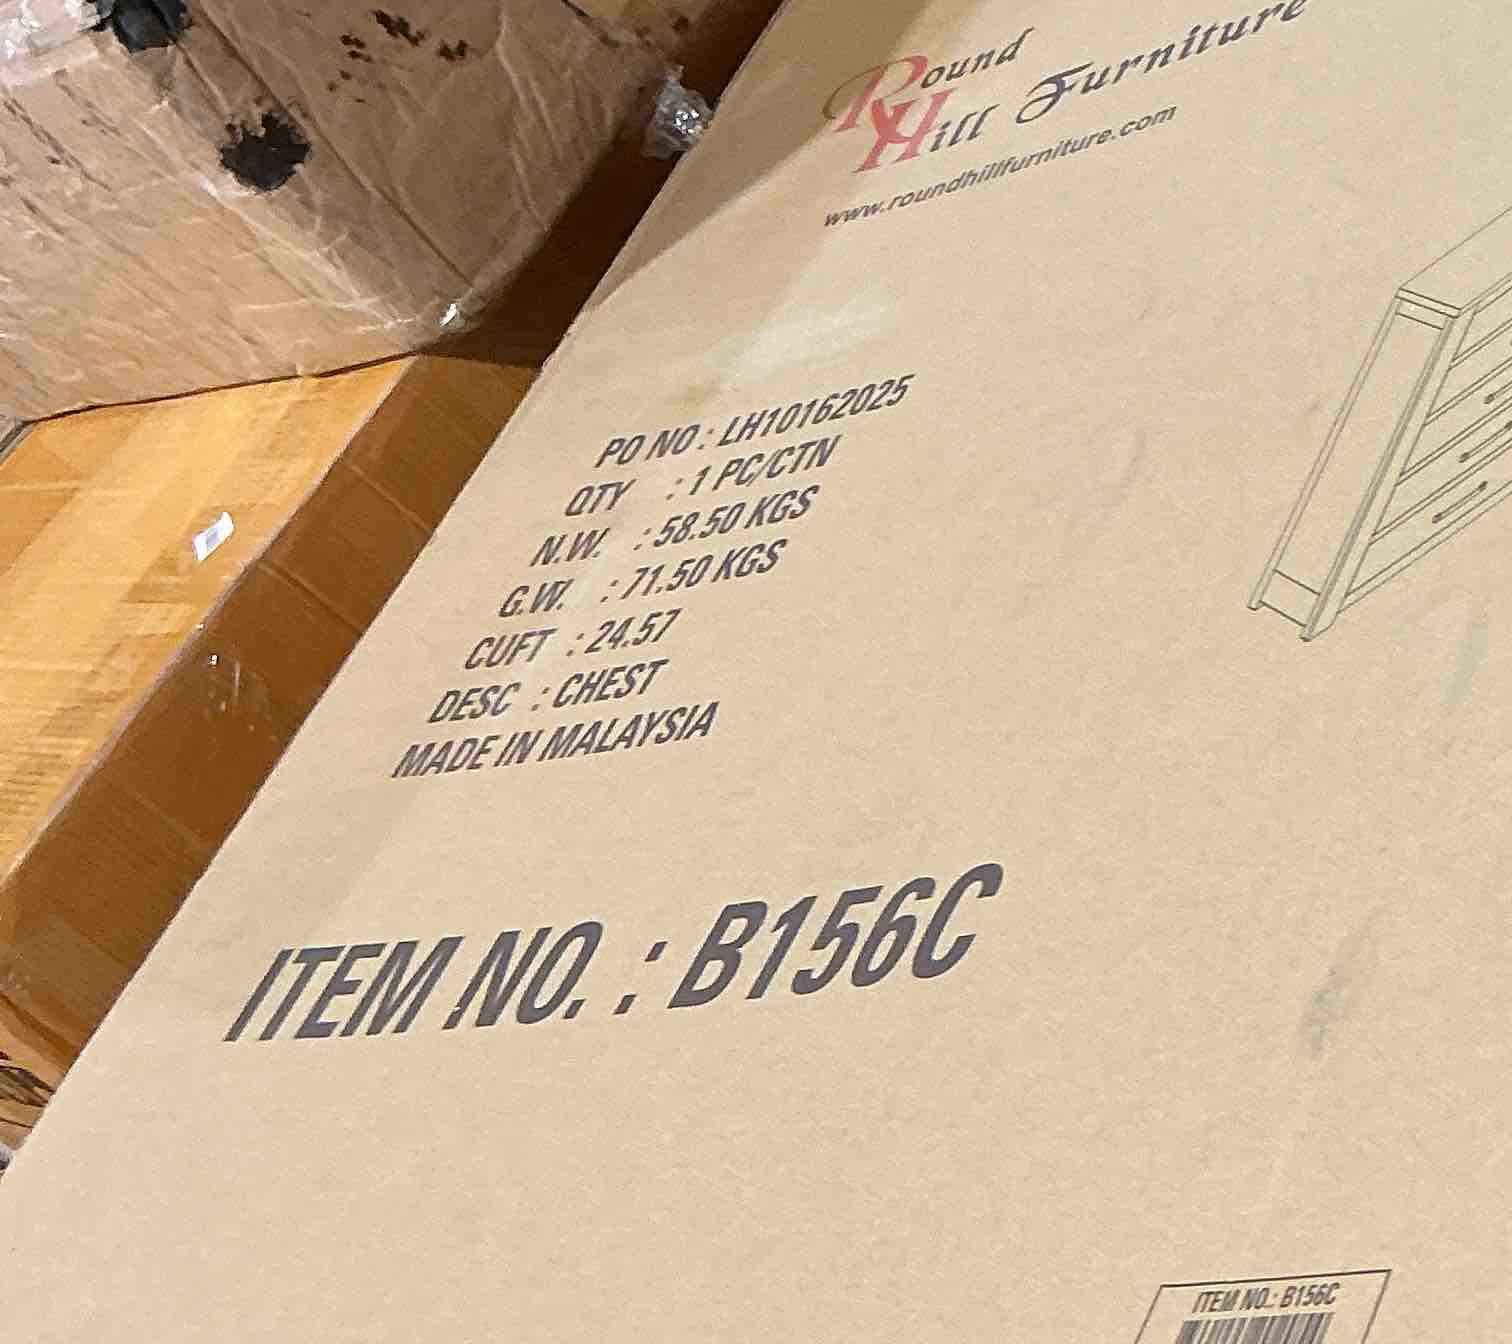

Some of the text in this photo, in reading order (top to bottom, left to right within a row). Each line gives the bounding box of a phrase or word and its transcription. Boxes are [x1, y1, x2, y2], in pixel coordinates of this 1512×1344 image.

[822, 26, 1035, 133] Round
[823, 105, 1177, 227] www.roundhillfurniture.com
[852, 88, 999, 173] Hill
[594, 435, 646, 469] PO
[716, 373, 916, 447] LH10162025
[564, 479, 636, 517] QTY
[688, 466, 709, 496] 1
[711, 434, 842, 492] PC/CTN
[530, 526, 611, 567] N.W.
[653, 502, 746, 548] 58.50
[744, 484, 820, 529] KGS
[499, 579, 573, 618] G.W.
[620, 553, 712, 601] 71.50
[713, 538, 788, 582] KGS
[464, 628, 557, 671] CUFT
[584, 607, 682, 654] 24.57
[427, 682, 520, 723] DESC
[552, 658, 669, 709] CHEST
[392, 701, 720, 779] MADE IN MALAYSIA
[223, 935, 463, 1042] ITEM
[667, 862, 1004, 1010] B156C
[1192, 1290, 1238, 1314] ITEM
[1279, 1282, 1340, 1308] B156C
